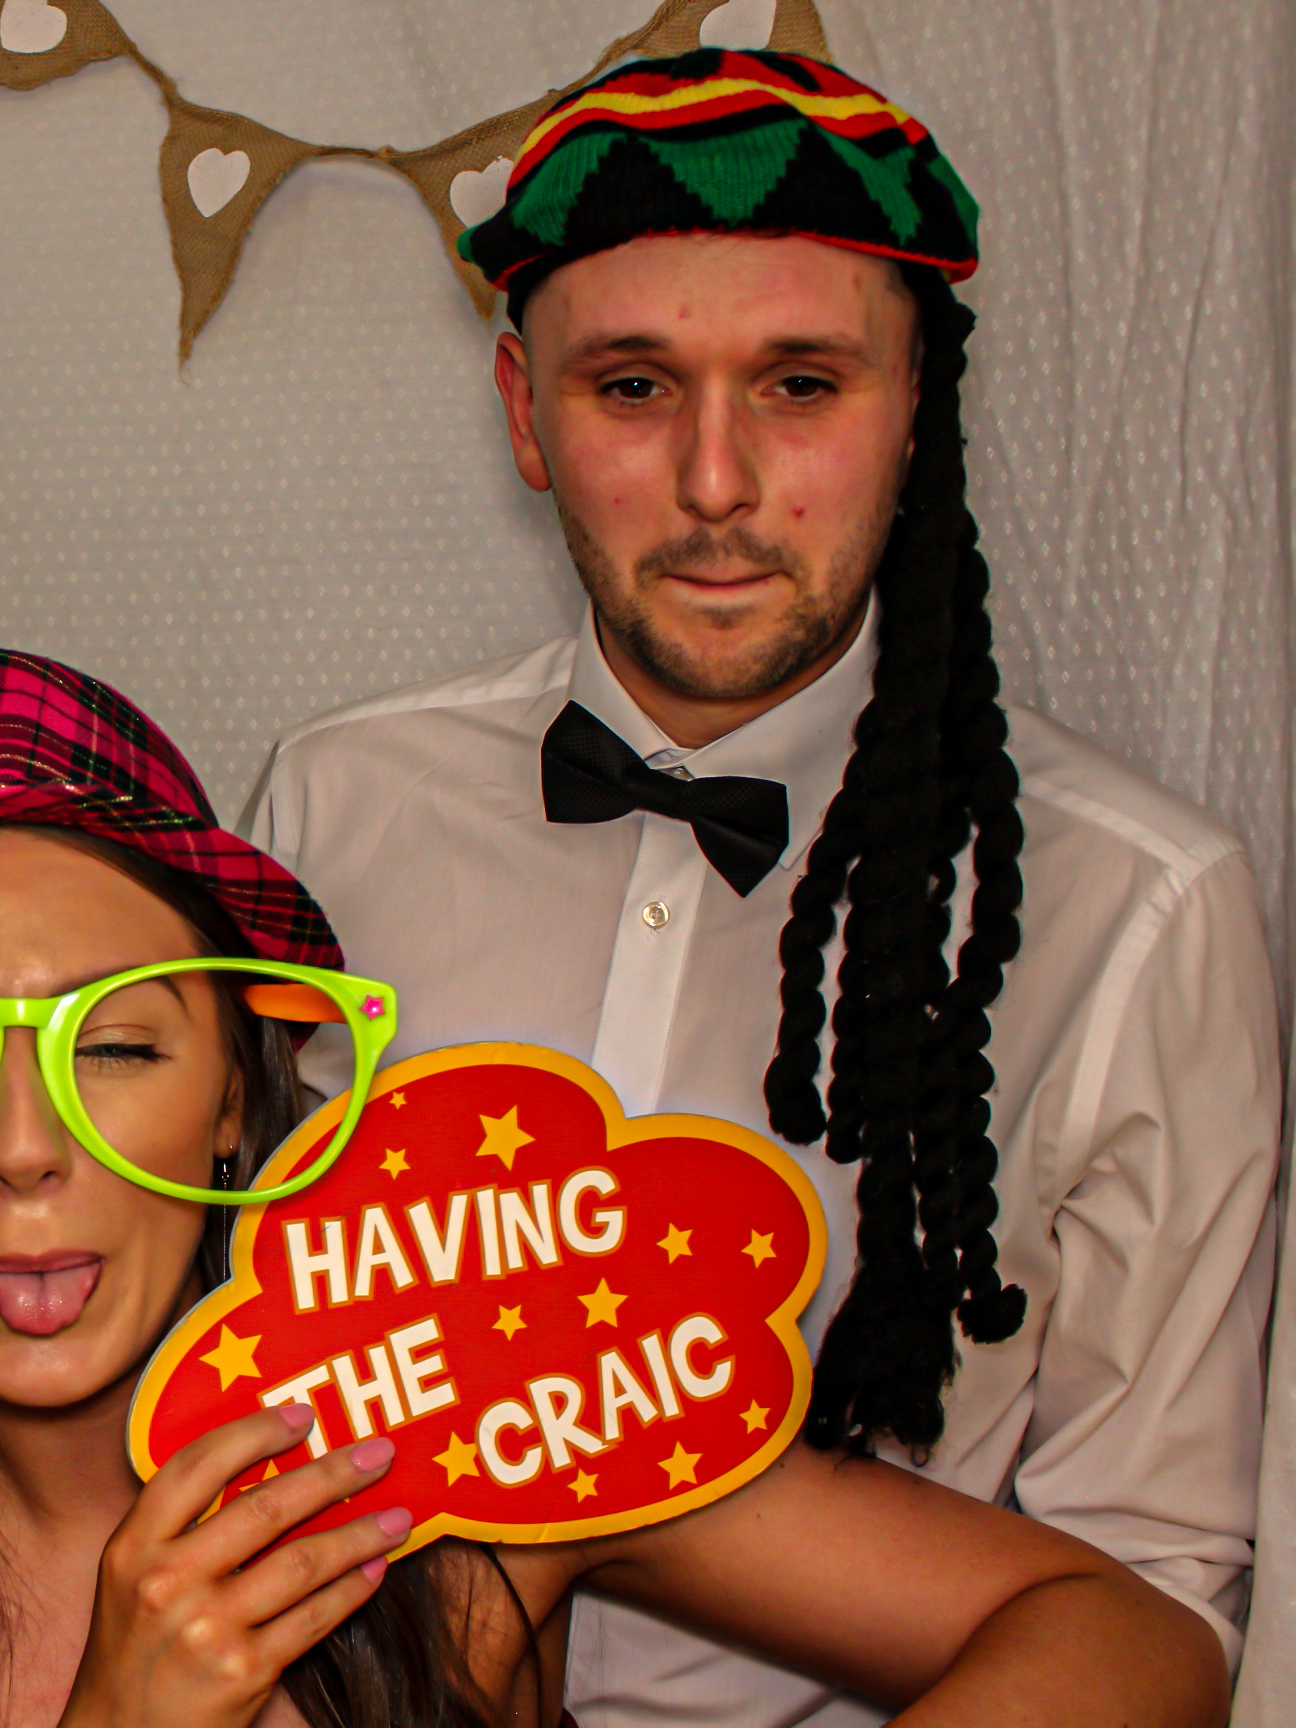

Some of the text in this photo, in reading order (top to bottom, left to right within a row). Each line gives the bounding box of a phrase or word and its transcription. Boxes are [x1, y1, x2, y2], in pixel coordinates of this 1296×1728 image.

[285, 1169, 624, 1310] HAVING
[261, 1315, 732, 1485] THE CRAIC
